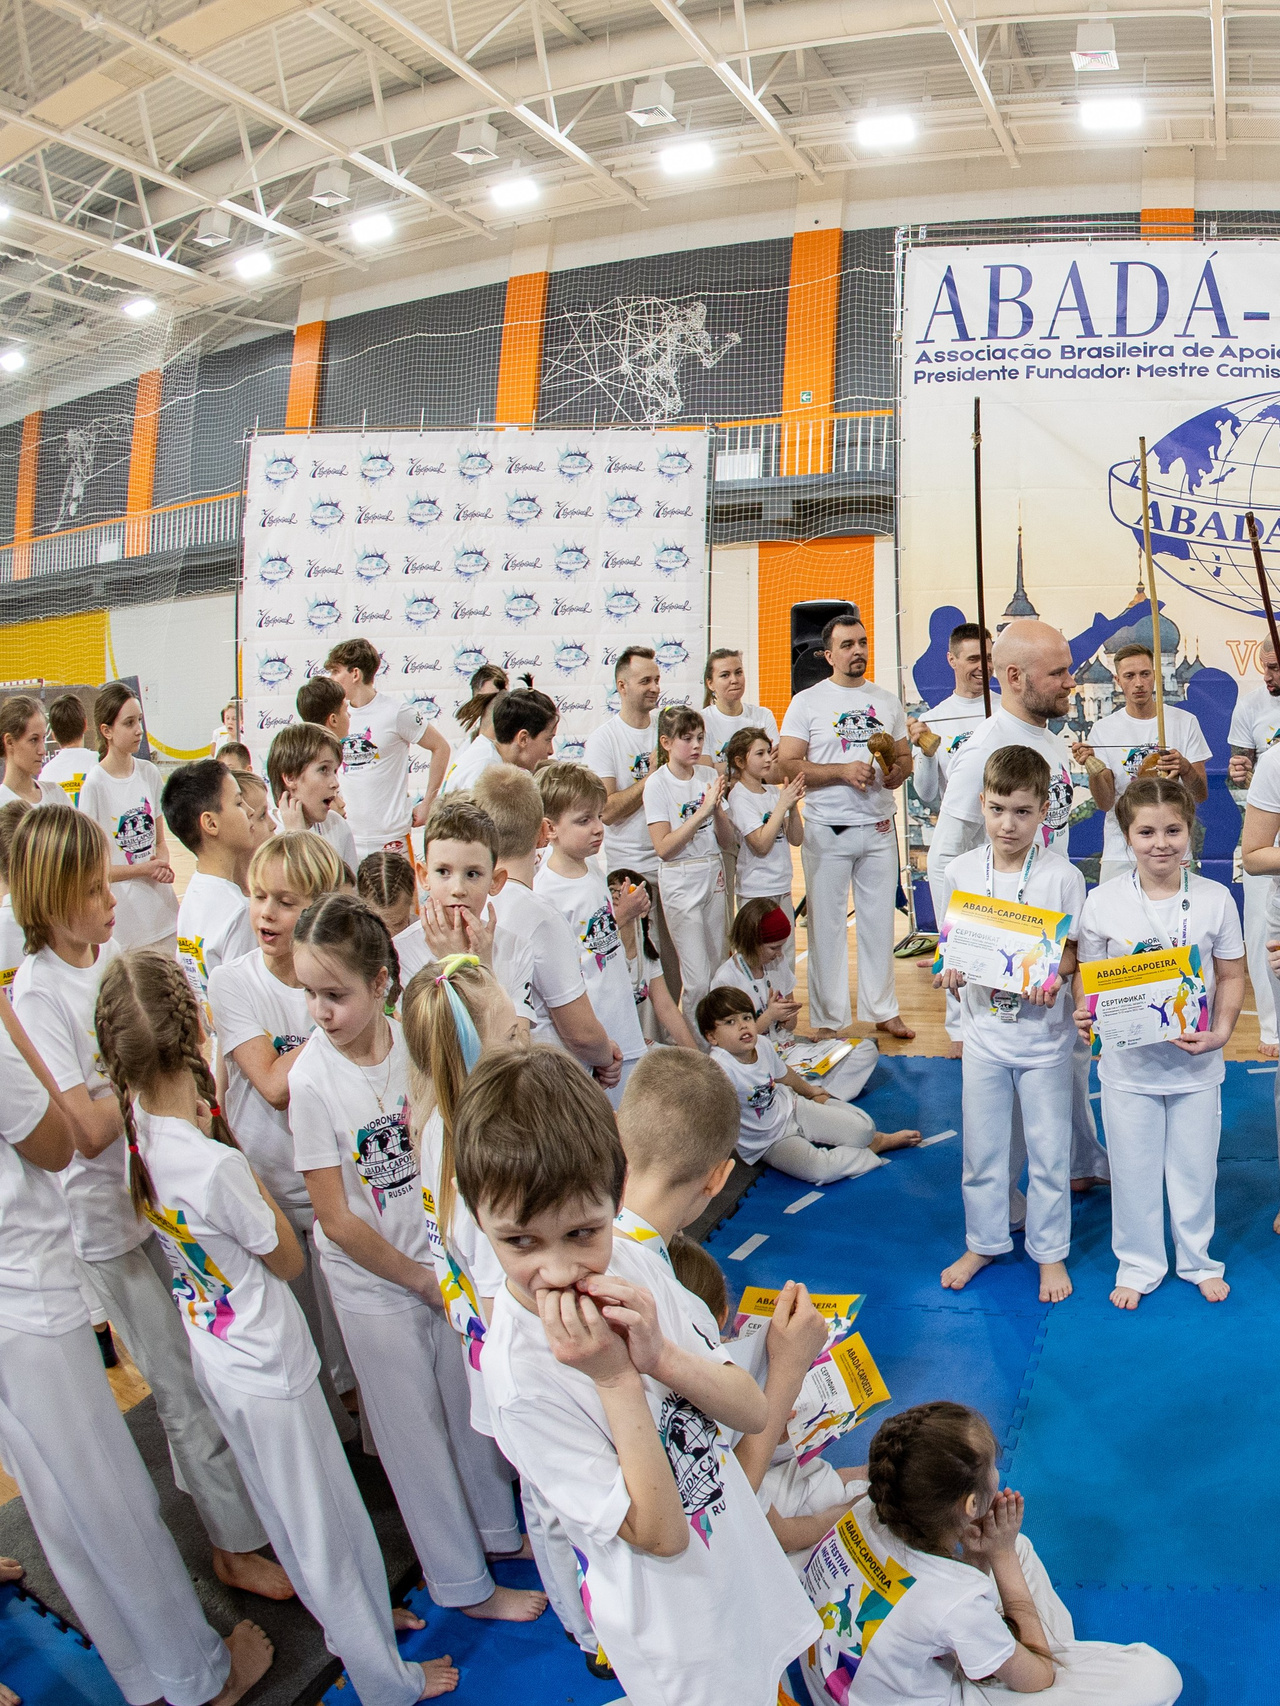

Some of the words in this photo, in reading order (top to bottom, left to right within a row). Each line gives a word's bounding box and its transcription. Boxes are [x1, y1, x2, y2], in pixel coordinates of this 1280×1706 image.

[915, 343, 1051, 364] Associação
[1060, 341, 1174, 360] Brasileira
[1182, 342, 1215, 358] de
[914, 366, 1019, 384] Presidente
[1026, 364, 1131, 380] Fundador:
[1137, 363, 1209, 378] Mestre
[963, 902, 1044, 925] ABADÁ-CAPOEIRA
[955, 928, 1000, 943] СЕРТИФИКАТ
[1097, 959, 1177, 979] ABADÁ-CAPOEIRA
[1101, 994, 1146, 1007] СЕРТИФИКАТ
[364, 1113, 406, 1132] VORONEZH
[388, 1185, 414, 1199] RUSSIA
[846, 1348, 874, 1398] ABADÁ-CAPOEIRA
[821, 1546, 840, 1579] INFANTIL
[844, 1520, 892, 1589] ABADÁ-CAPOEIRA
